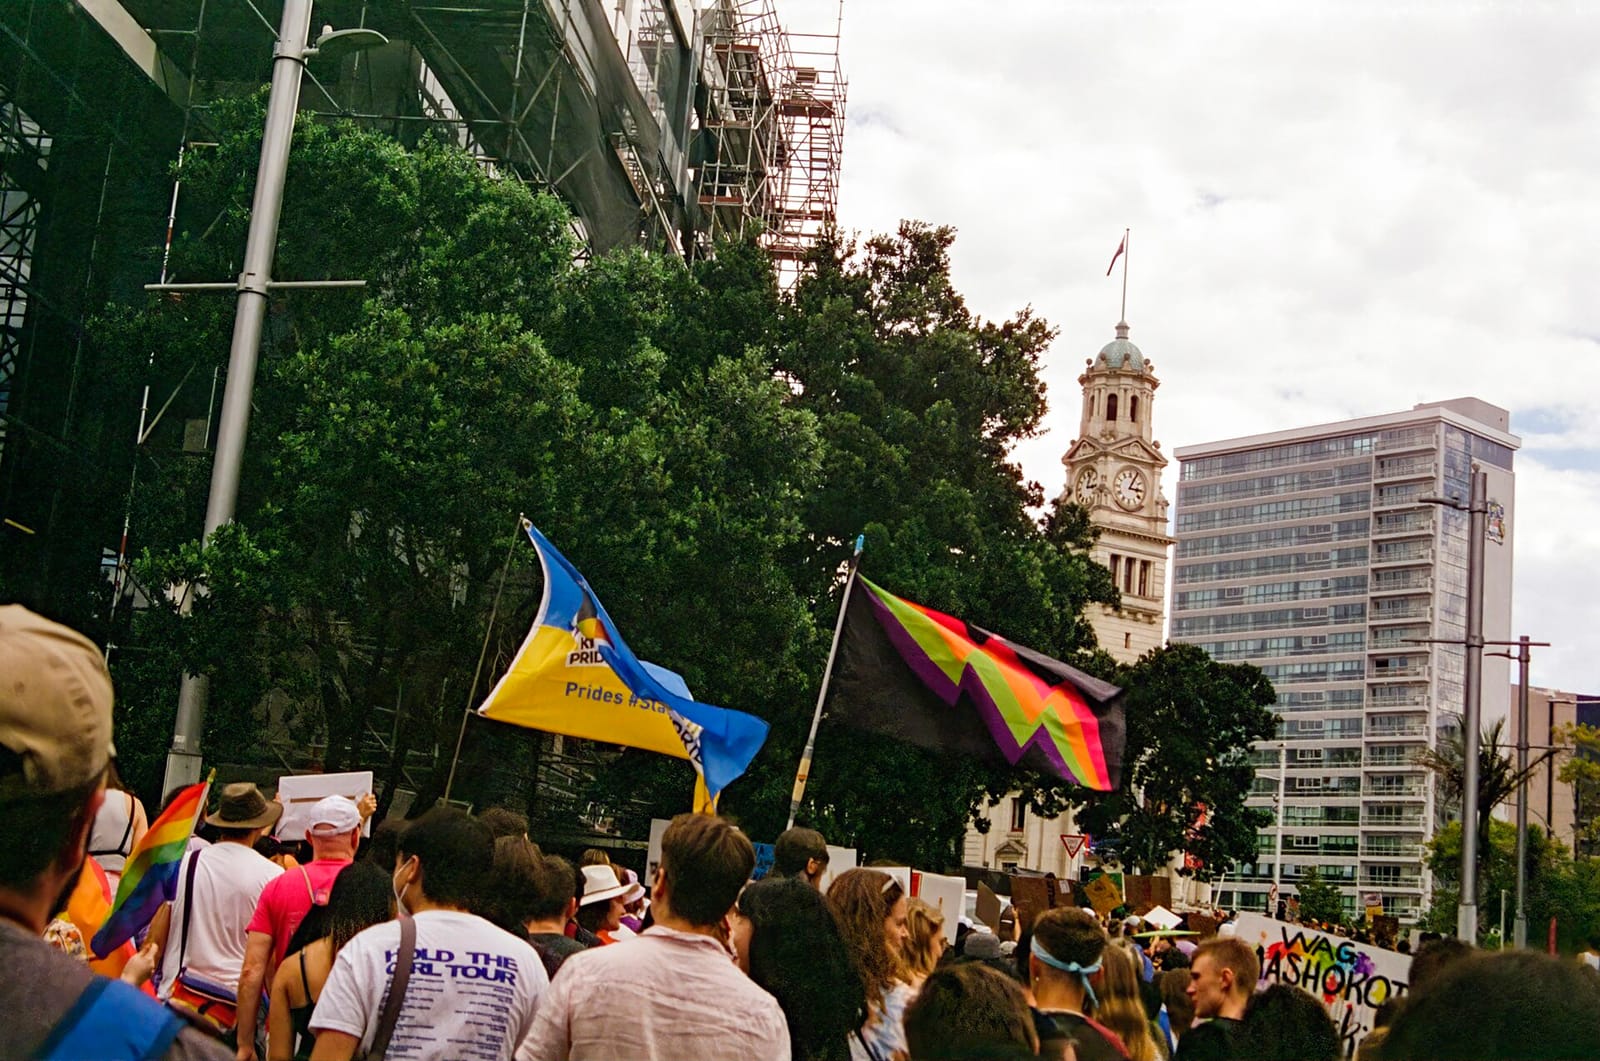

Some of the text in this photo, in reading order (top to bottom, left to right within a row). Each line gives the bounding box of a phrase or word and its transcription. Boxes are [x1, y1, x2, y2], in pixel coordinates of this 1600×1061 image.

[565, 682, 623, 705] Prides
[1281, 926, 1356, 965] WAG
[386, 962, 516, 987] GRL TOUR
[466, 952, 518, 973] THE
[1256, 945, 1408, 1009] ASHOKOT
